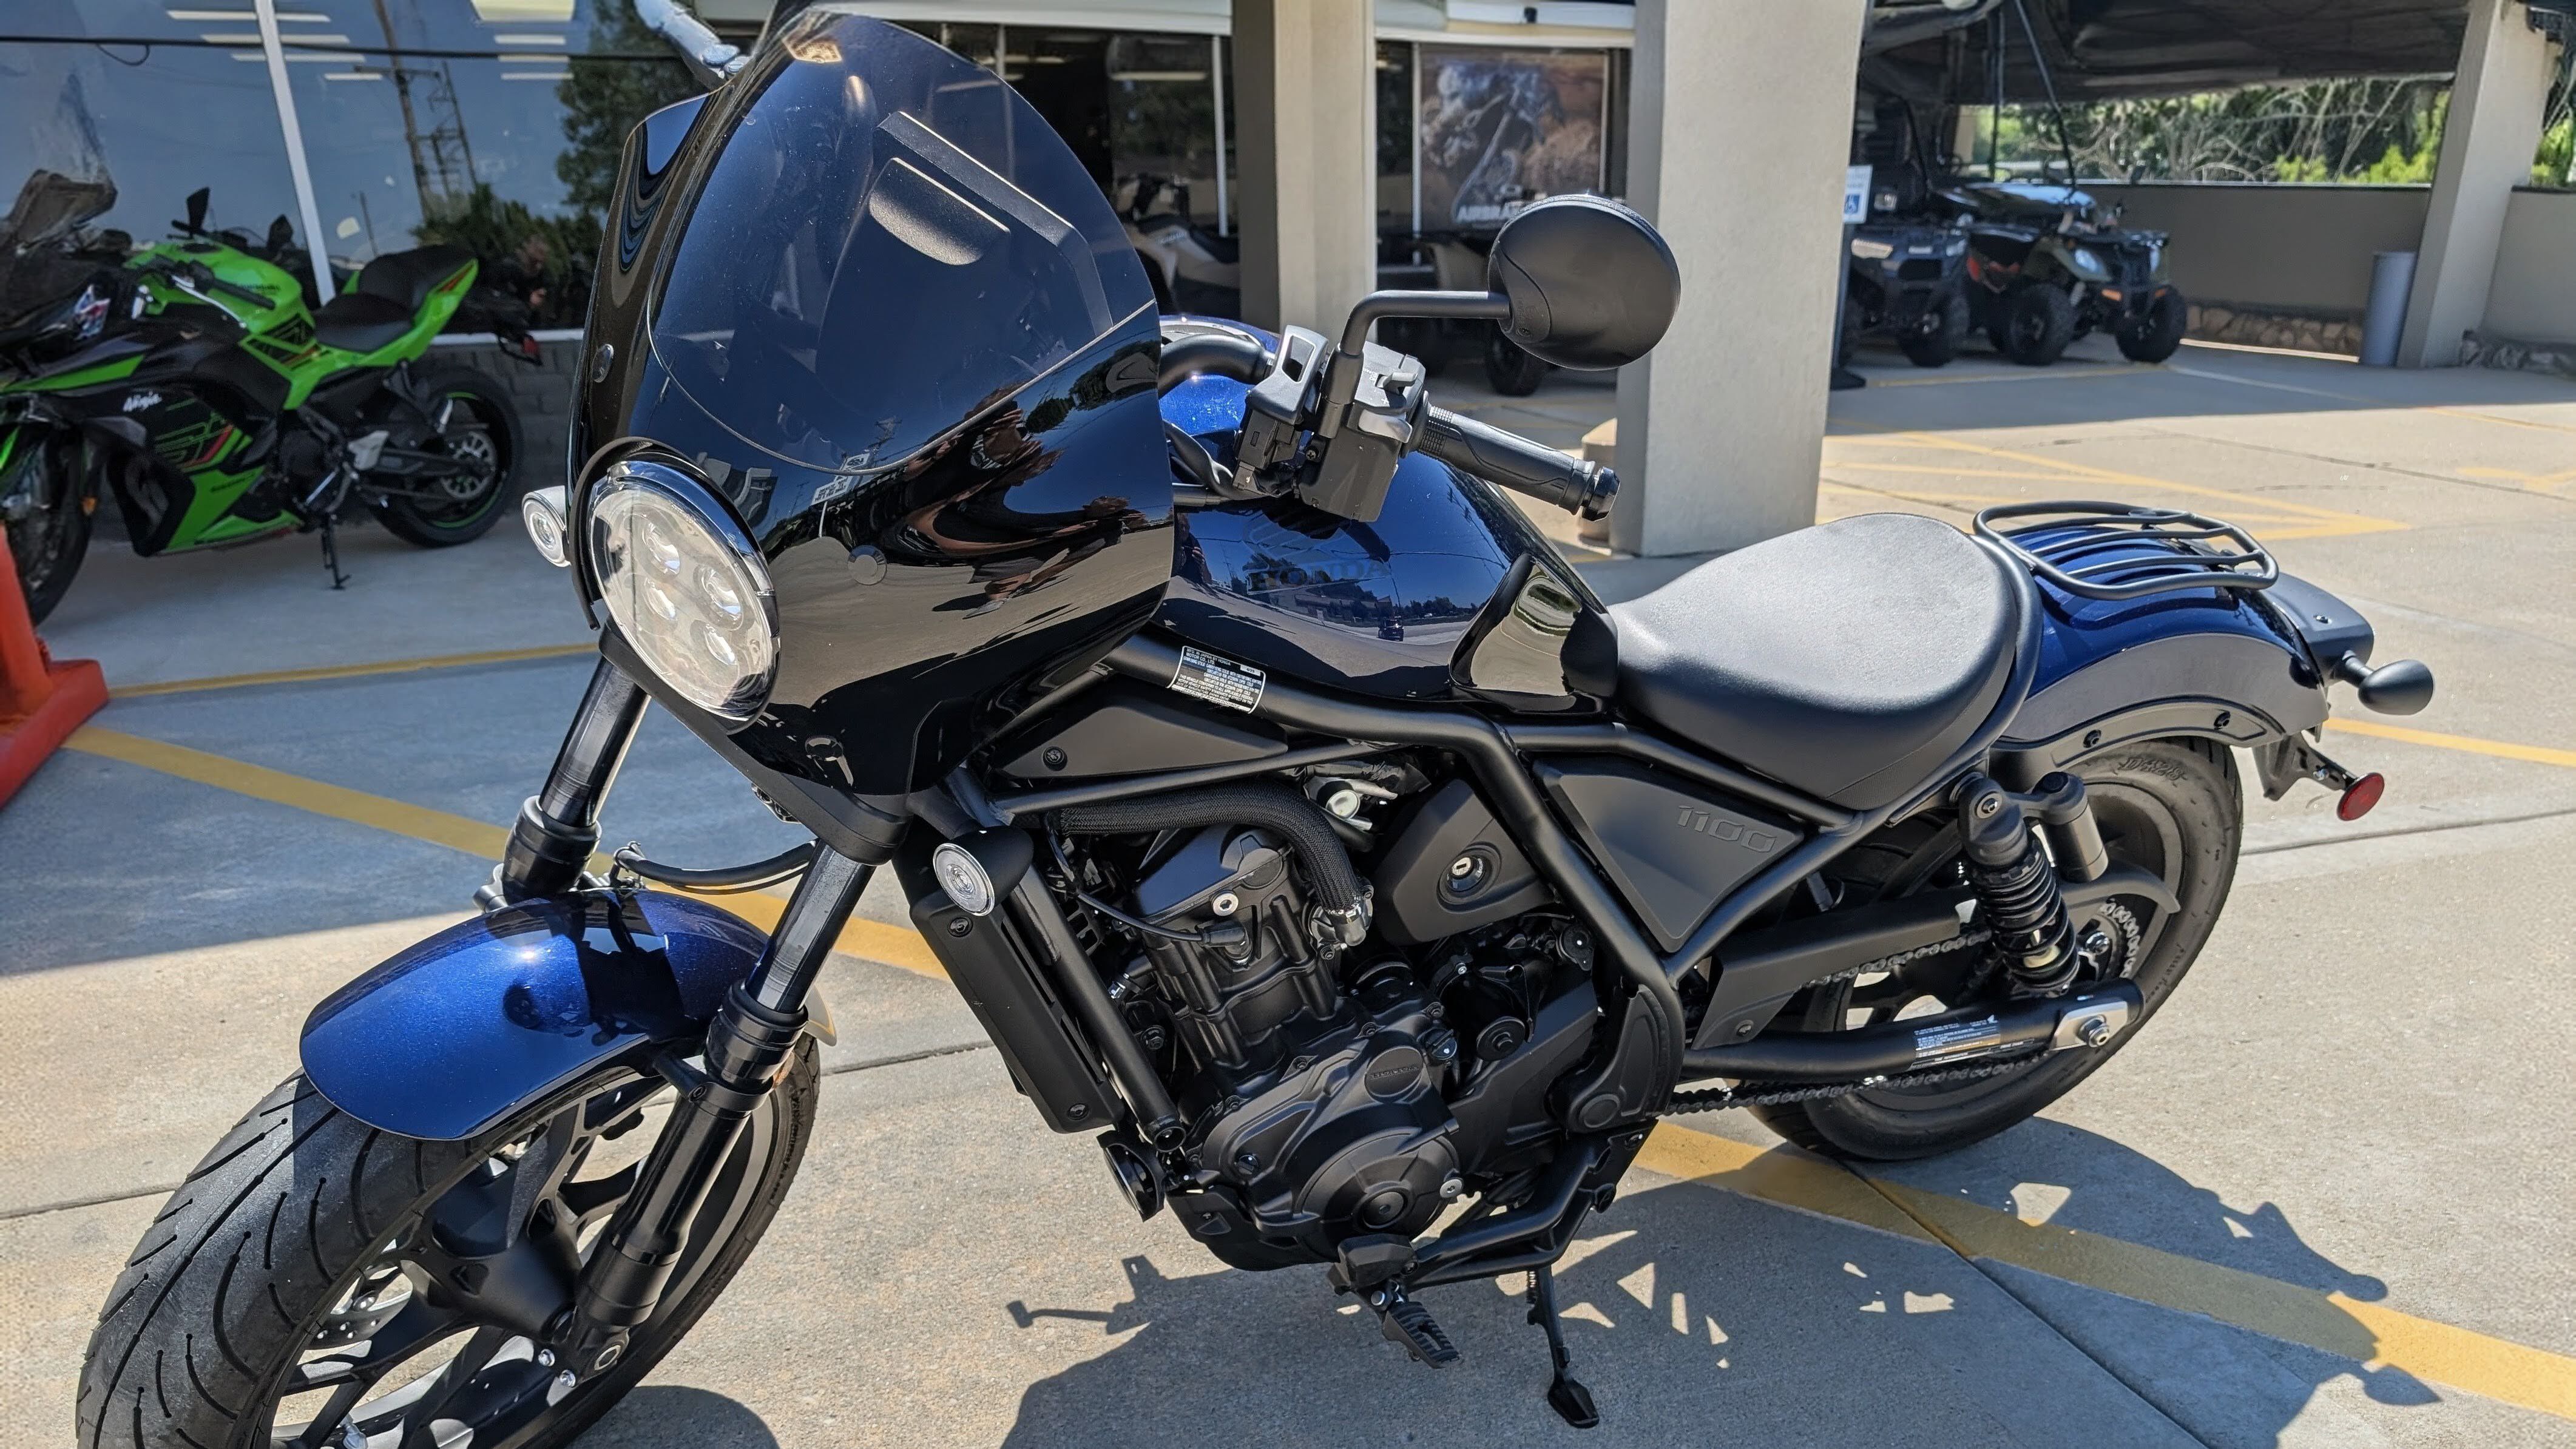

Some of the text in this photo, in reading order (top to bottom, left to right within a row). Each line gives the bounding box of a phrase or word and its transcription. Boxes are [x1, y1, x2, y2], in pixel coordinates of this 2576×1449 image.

[123, 391, 162, 412] Ninja
[1248, 558, 1390, 593] HONDA
[1677, 805, 1777, 853] 1100
